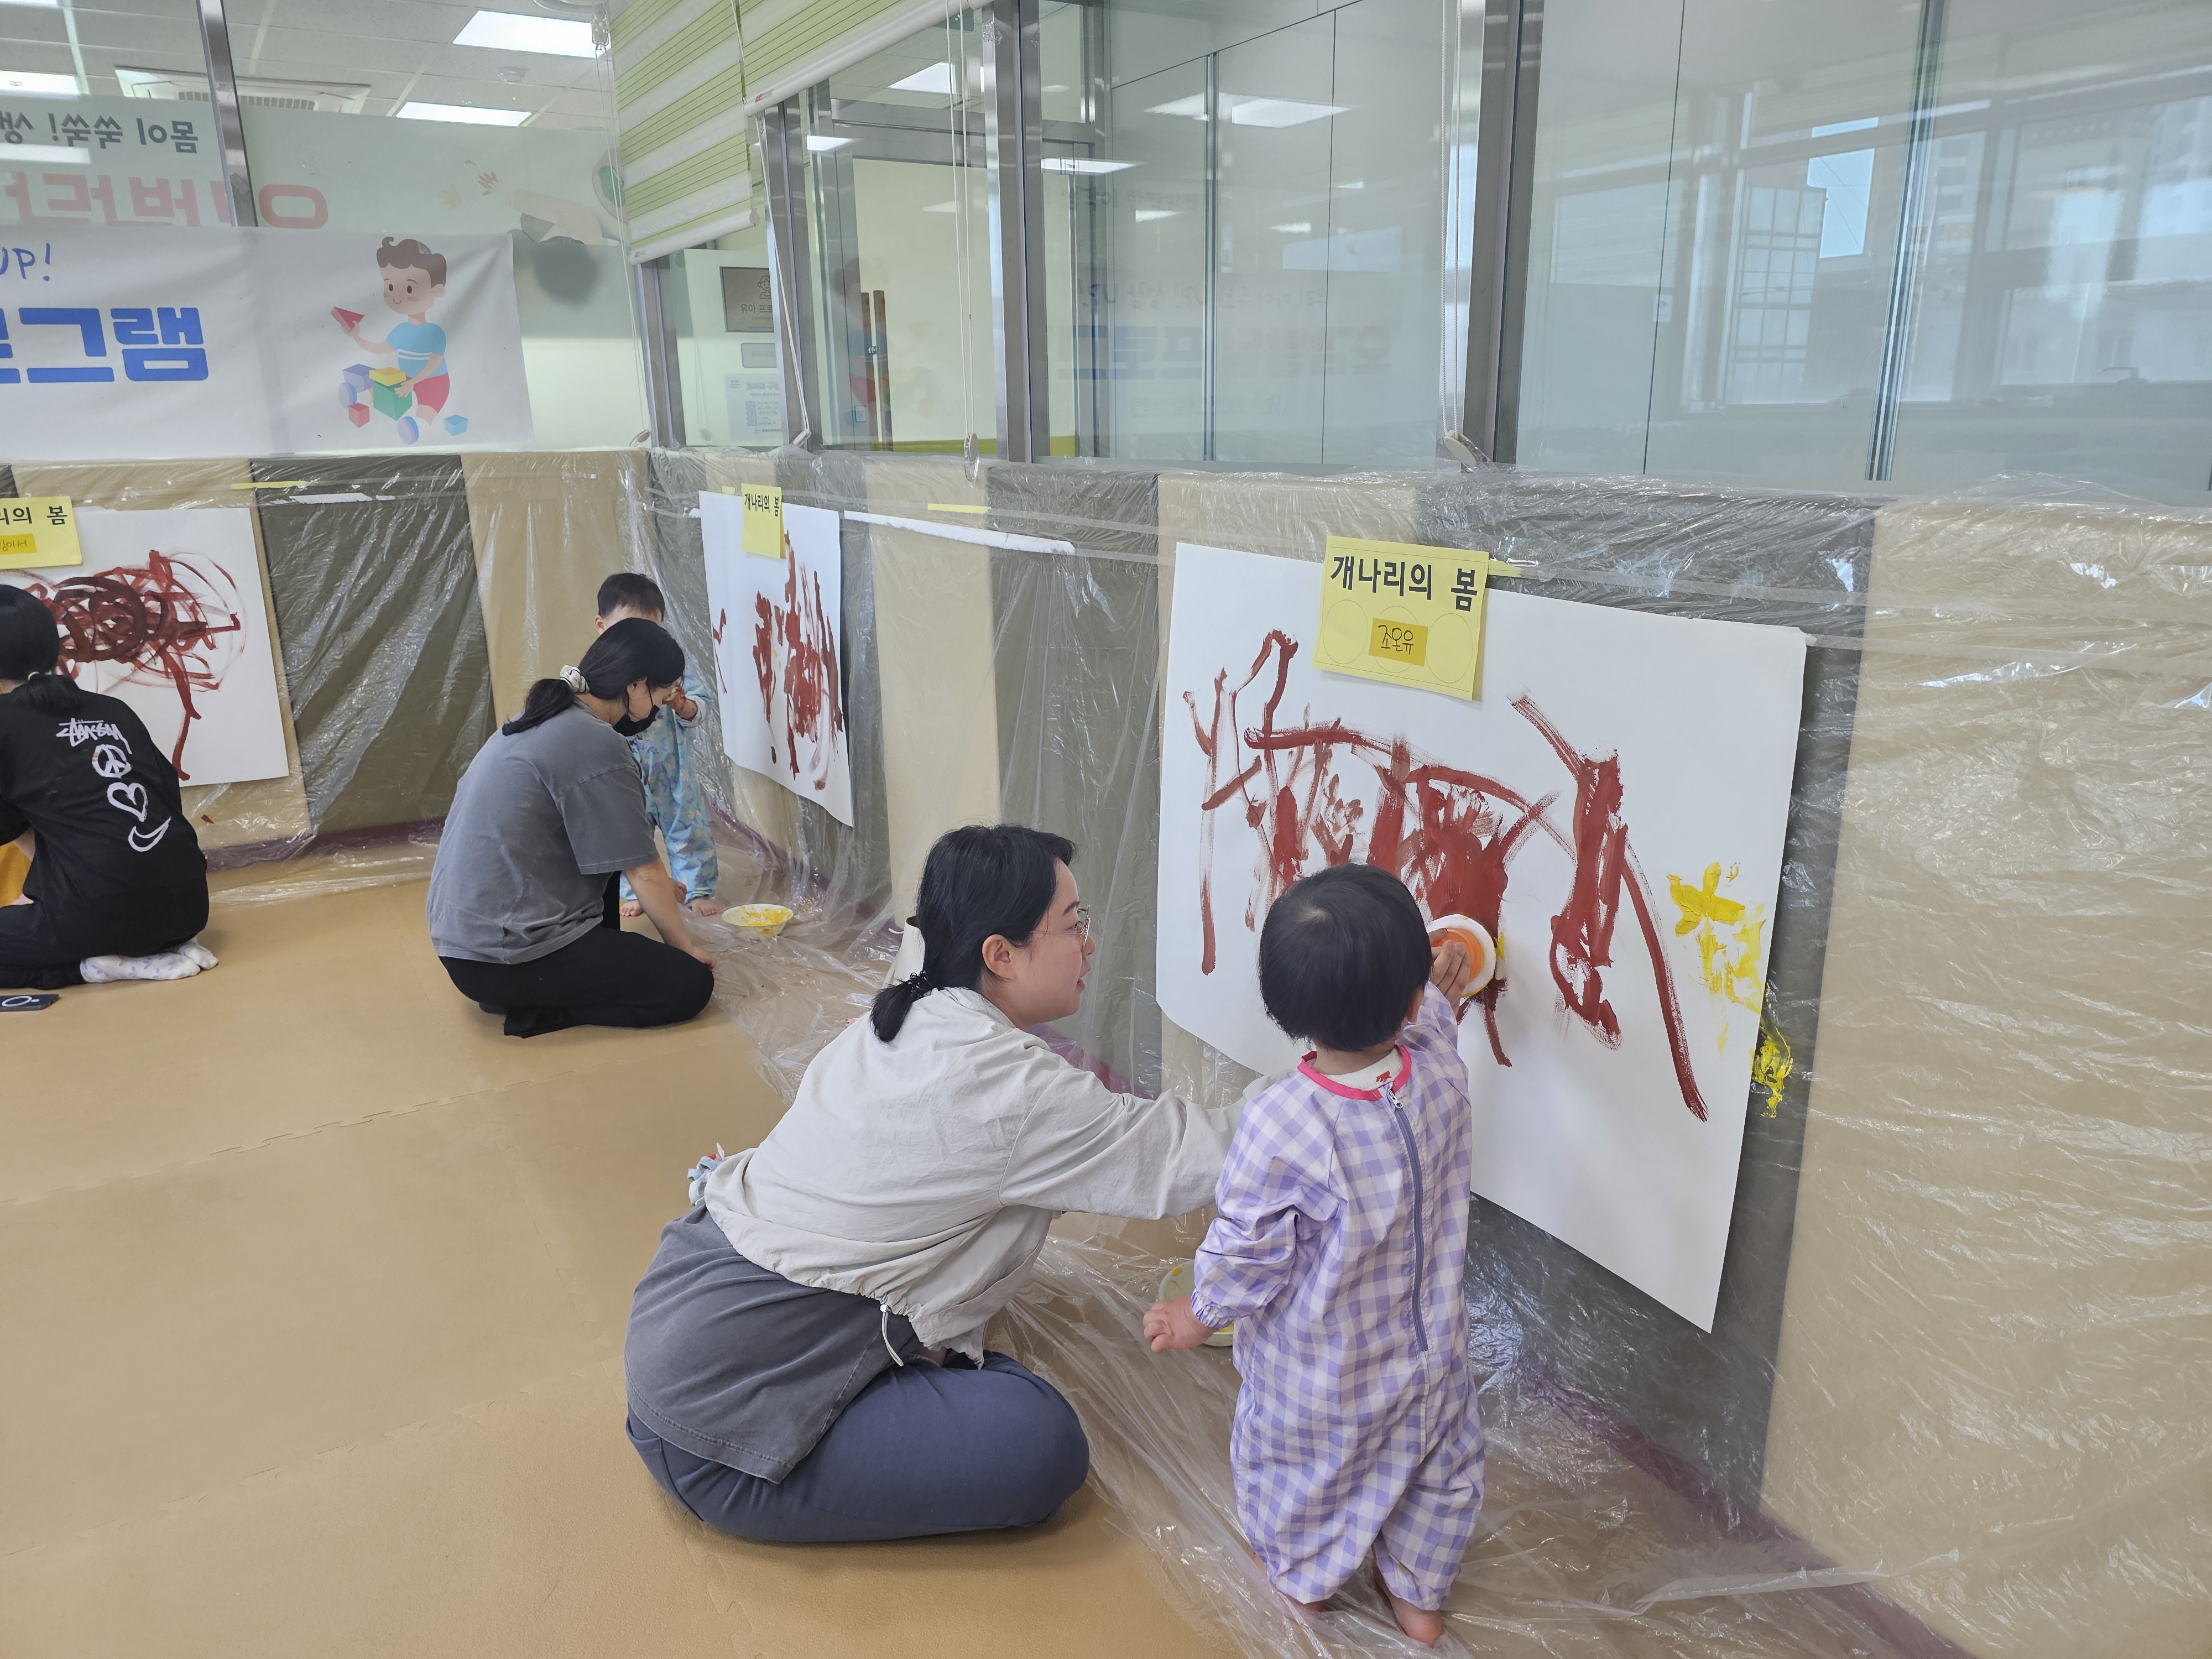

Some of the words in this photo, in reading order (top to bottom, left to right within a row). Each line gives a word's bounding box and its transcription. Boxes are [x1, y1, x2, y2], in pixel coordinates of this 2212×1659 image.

[740, 304, 756, 314] 유아
[47, 506, 67, 525] 봄
[744, 493, 770, 513] 개나리의
[774, 497, 779, 517] 봄
[1330, 556, 1432, 600] 개나리의
[1451, 568, 1477, 612] 봄
[1378, 624, 1414, 655] 조온유
